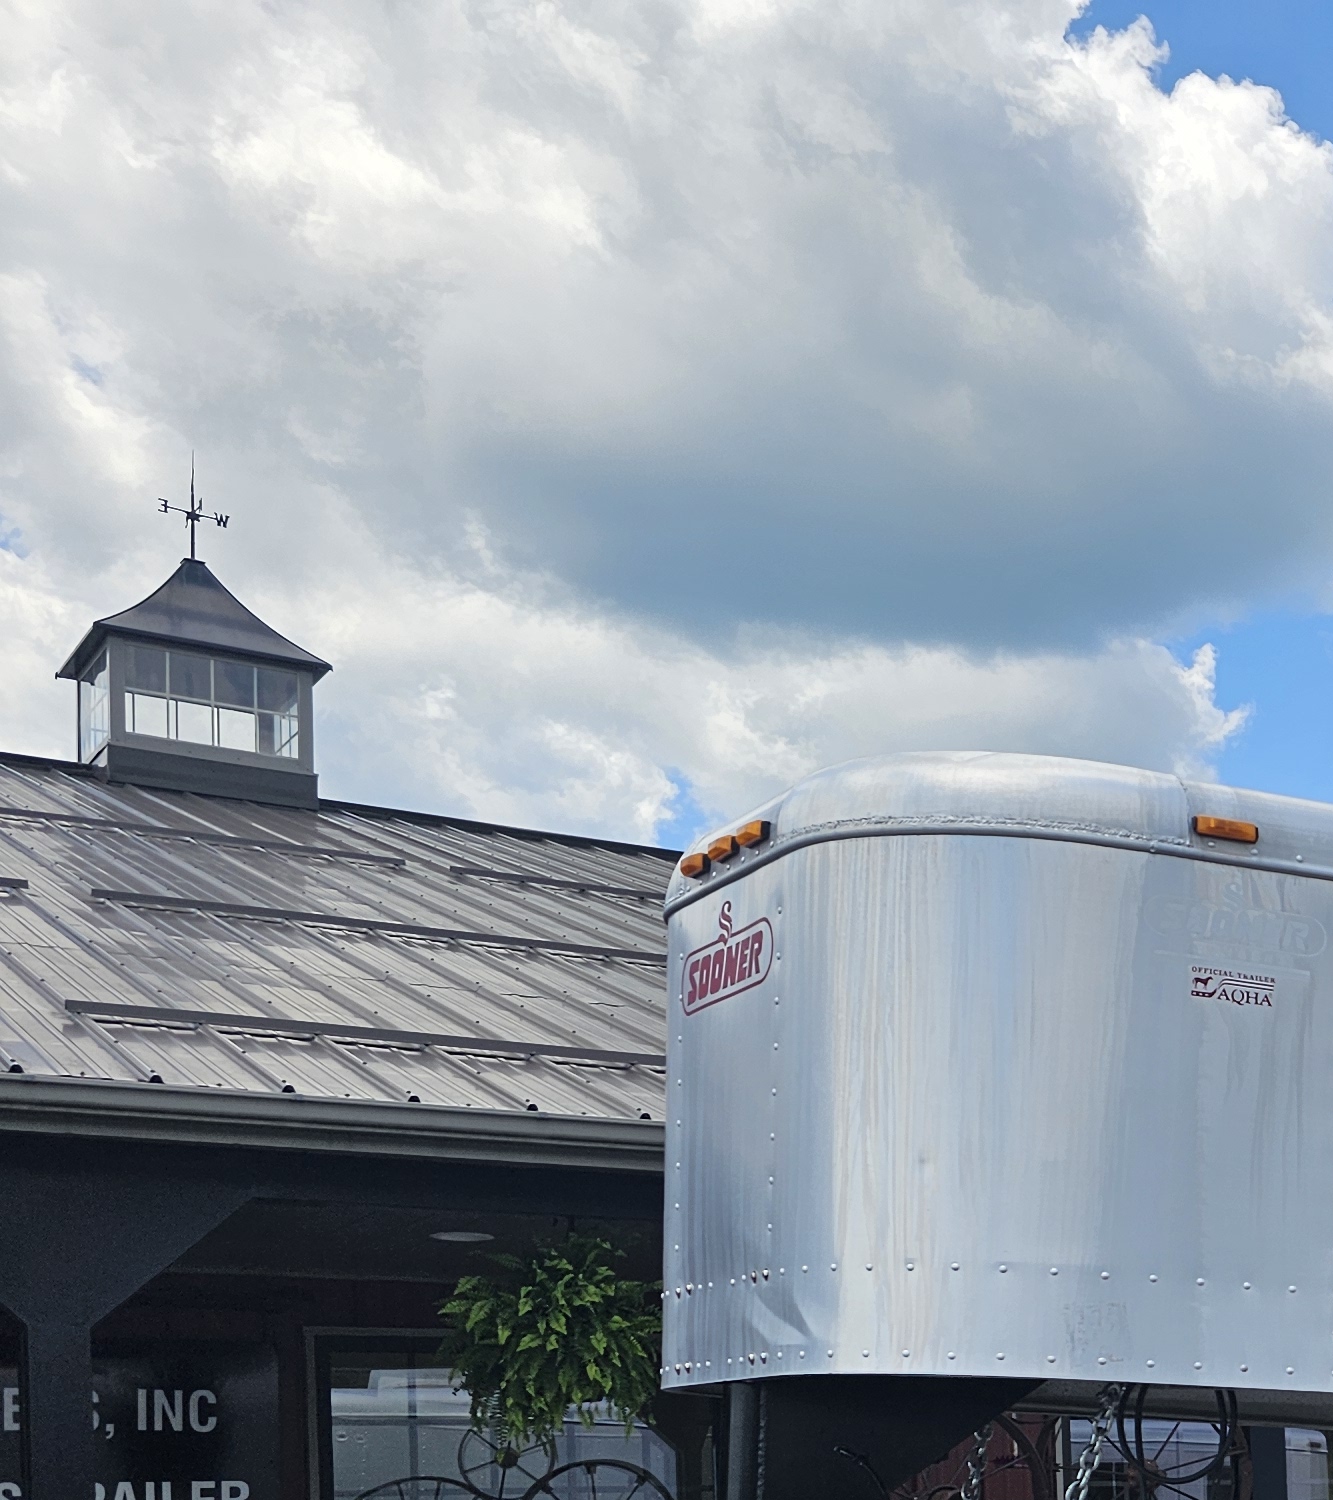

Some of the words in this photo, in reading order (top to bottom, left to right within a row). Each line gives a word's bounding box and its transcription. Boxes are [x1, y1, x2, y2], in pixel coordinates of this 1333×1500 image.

[687, 930, 763, 1006] SOONER
[1191, 966, 1234, 977] OFFICIAL
[1237, 972, 1276, 983] TRAILER
[1217, 988, 1273, 1007] AQHA
[137, 1388, 217, 1433] INC
